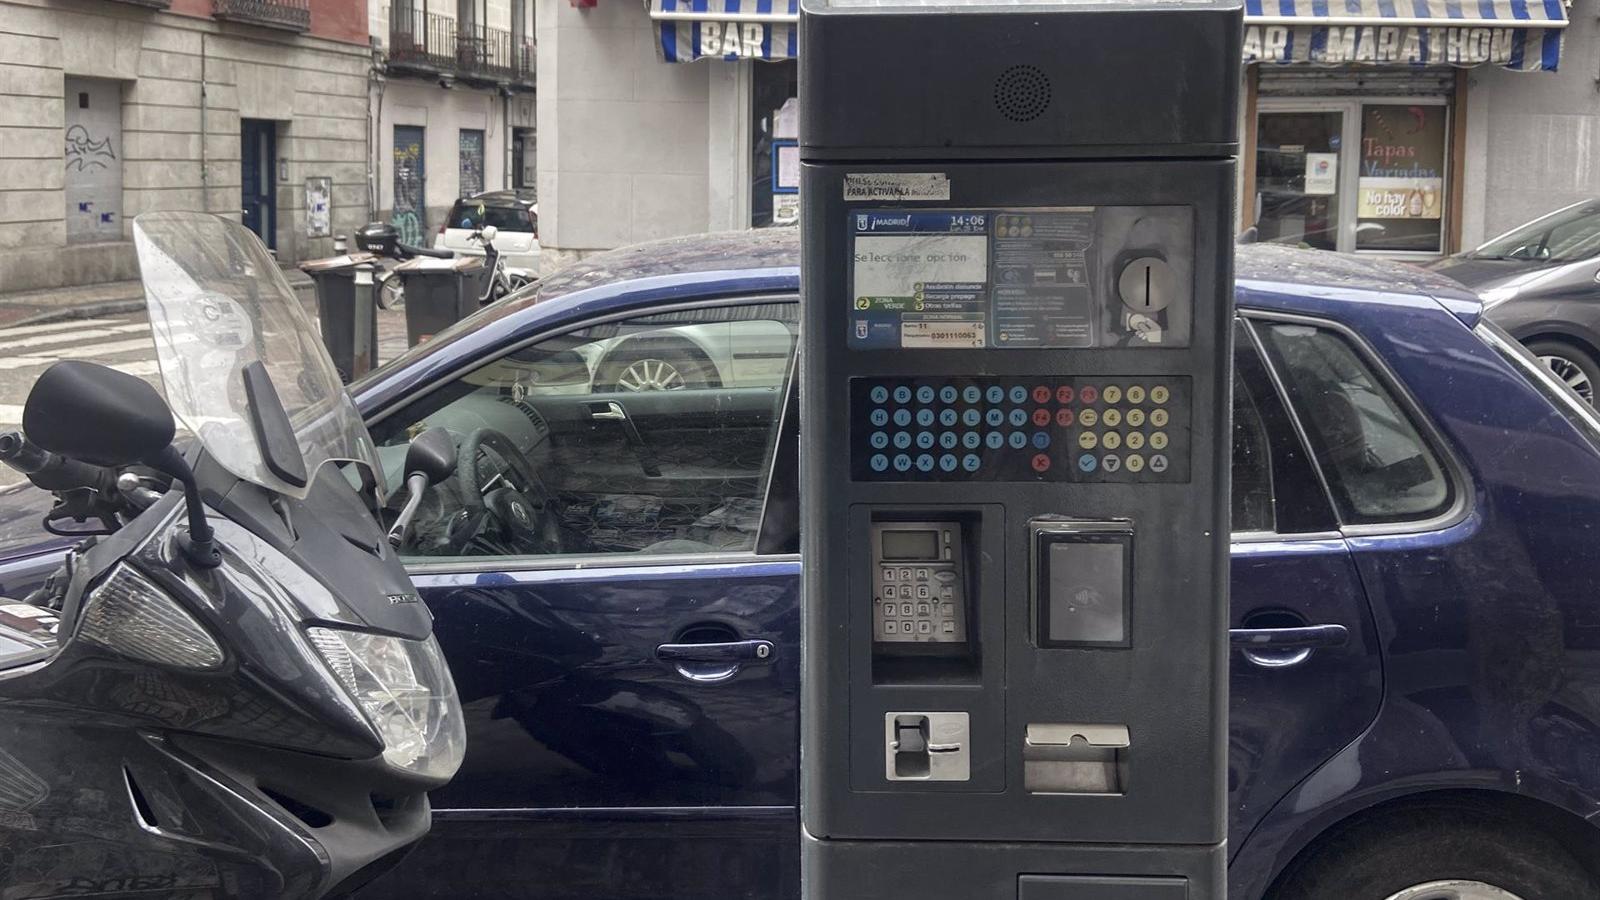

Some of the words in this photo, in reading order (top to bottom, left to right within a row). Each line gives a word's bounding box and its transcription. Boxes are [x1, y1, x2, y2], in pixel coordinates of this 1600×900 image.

[701, 21, 764, 56] BAR
[1243, 26, 1288, 60] AR
[1326, 26, 1512, 62] MARATHON
[1362, 138, 1416, 164] Tapas
[848, 187, 866, 196] PARA
[1366, 190, 1382, 205] No
[1384, 190, 1406, 206] hay
[1376, 203, 1407, 216] color
[951, 216, 984, 226] 14:06
[854, 252, 920, 262] Seleccione
[876, 391, 883, 399] A
[899, 391, 906, 399] B
[922, 391, 929, 399] C
[945, 391, 952, 399] D
[968, 391, 975, 399] E
[992, 391, 998, 399] F
[1014, 391, 1022, 399] G
[1133, 391, 1139, 399] 8
[1156, 391, 1163, 399] 9
[923, 414, 928, 422] J
[968, 413, 975, 422] L
[1132, 413, 1139, 422] 5
[1156, 413, 1162, 422] 6
[876, 436, 883, 444] O
[921, 436, 929, 444] Q
[945, 436, 952, 444] R
[968, 436, 975, 444] S
[1014, 436, 1022, 444] U
[1132, 436, 1138, 444] 2
[1156, 436, 1162, 445] 3
[945, 458, 952, 467] Y
[968, 459, 975, 467] Z
[1132, 459, 1138, 467] 0
